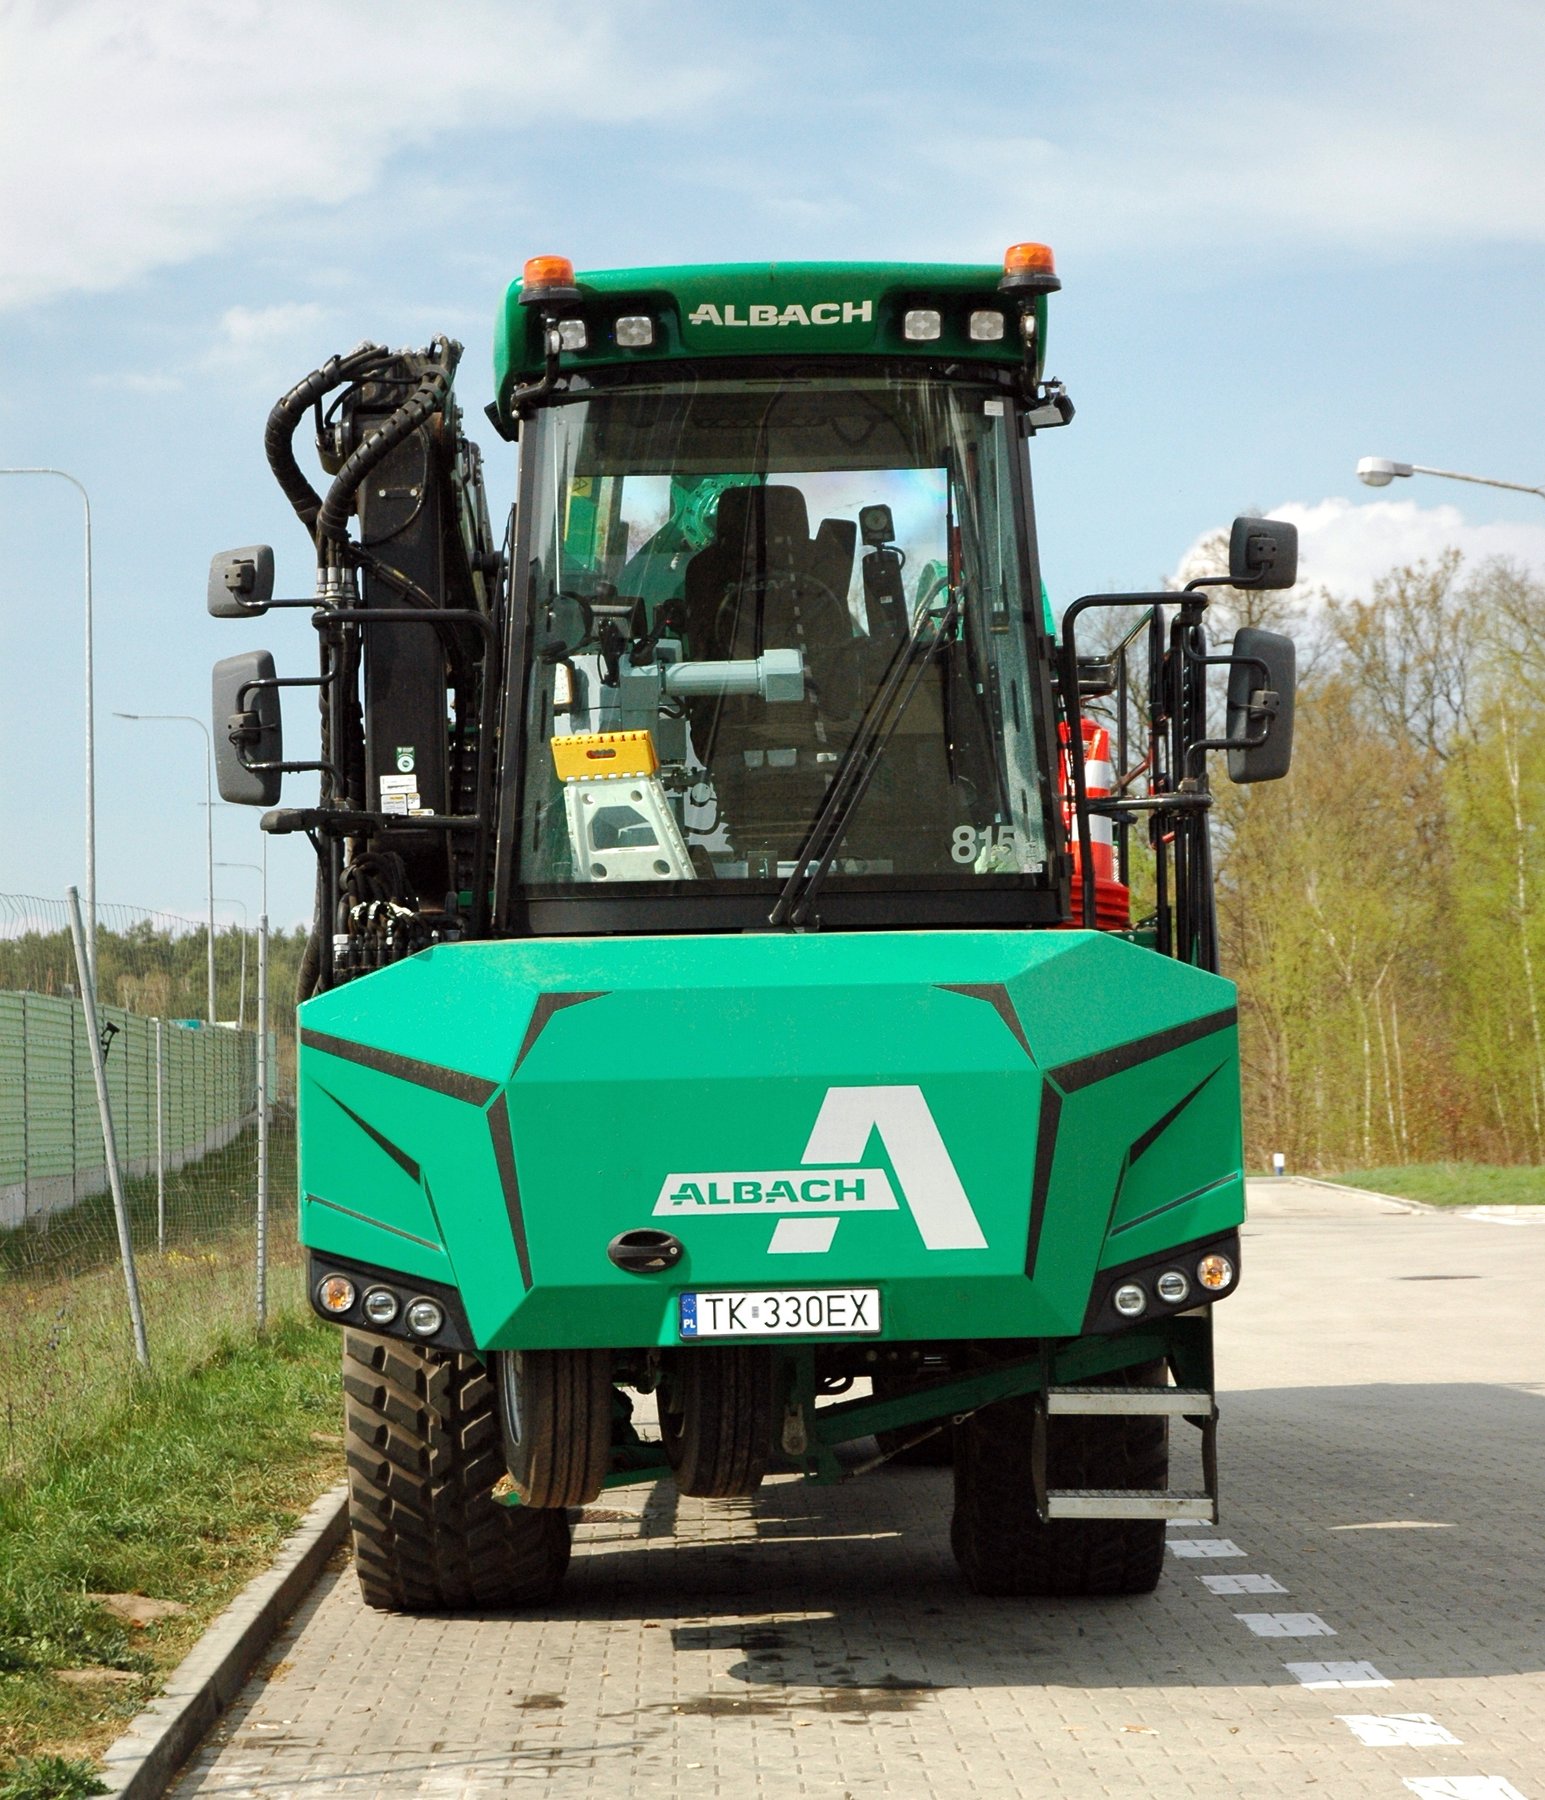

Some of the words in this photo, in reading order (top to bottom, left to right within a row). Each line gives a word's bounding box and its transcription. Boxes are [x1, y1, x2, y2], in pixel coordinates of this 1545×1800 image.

[688, 301, 872, 327] ALBACH
[951, 825, 1018, 864] 815
[670, 1179, 865, 1205] ALBACH
[683, 1318, 696, 1329] PL
[705, 1297, 748, 1330] TK
[763, 1294, 869, 1329] 330EX
